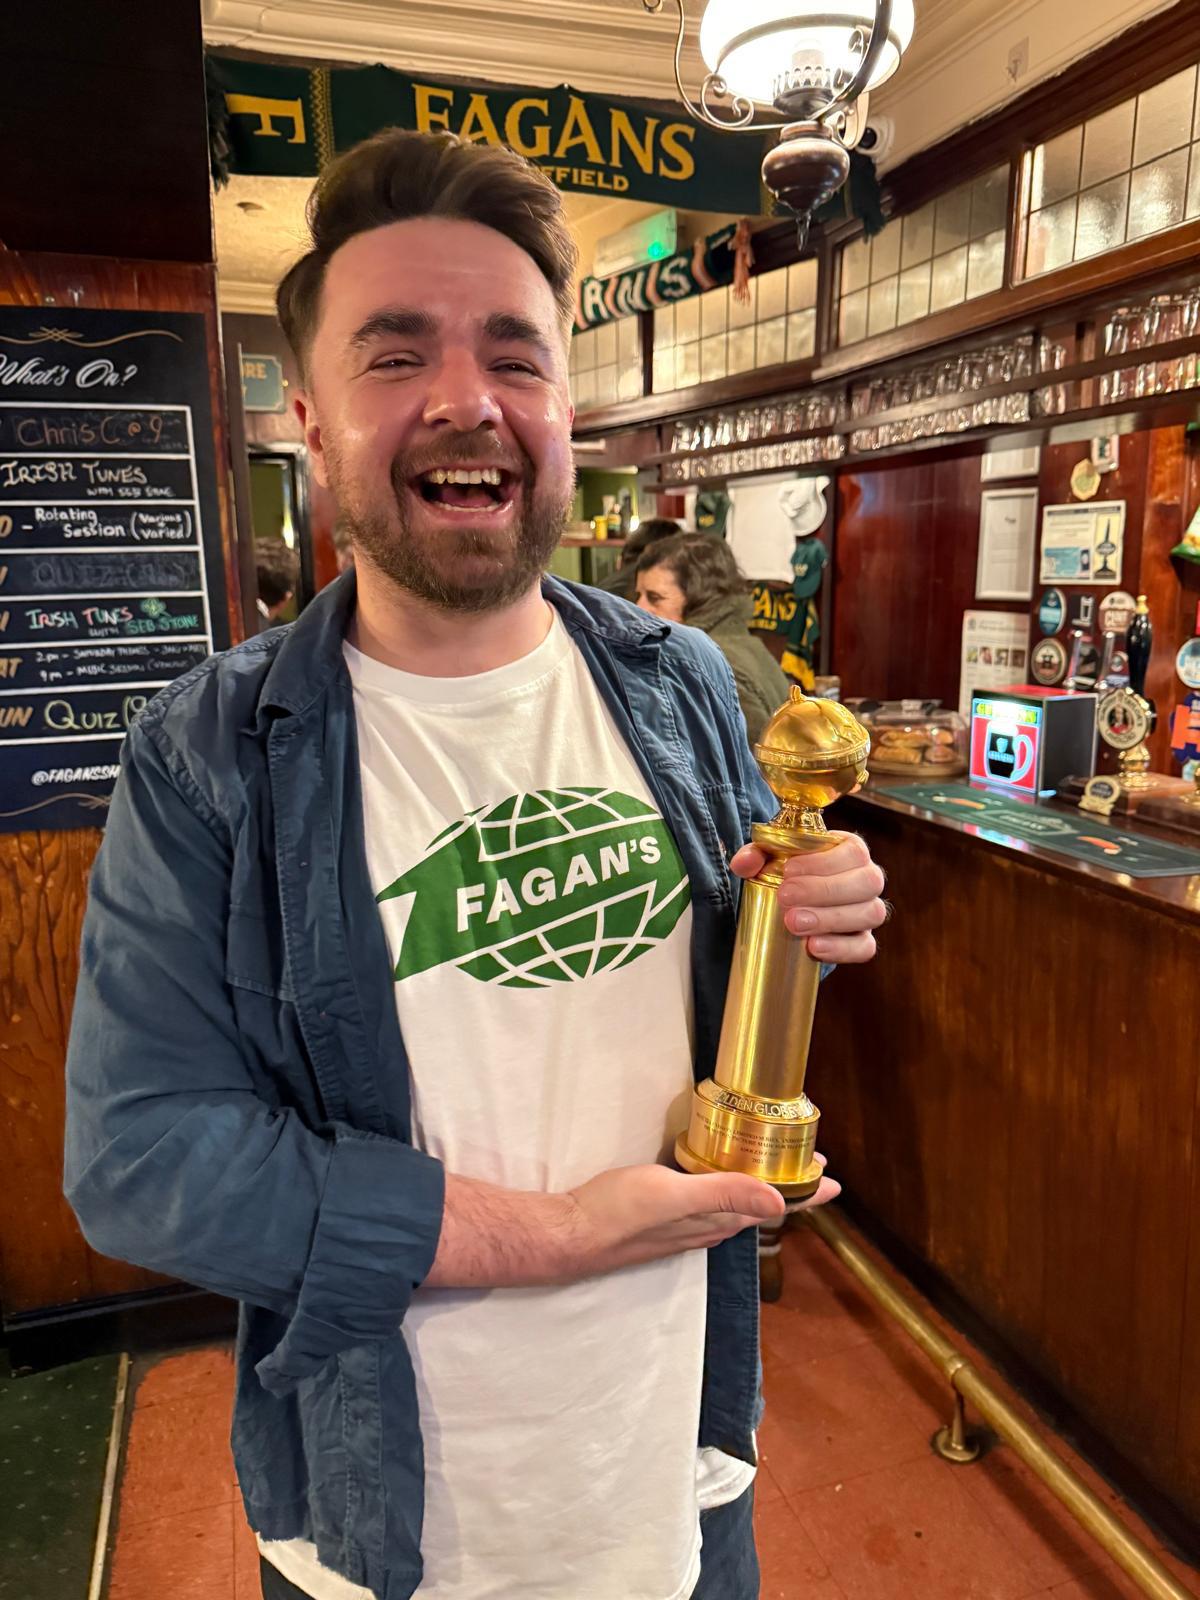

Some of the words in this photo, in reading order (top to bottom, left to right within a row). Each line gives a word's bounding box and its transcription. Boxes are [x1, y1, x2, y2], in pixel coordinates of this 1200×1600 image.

[411, 83, 697, 181] FAGANS
[76, 358, 138, 389] On?
[82, 461, 148, 485] TUNES
[35, 507, 98, 528] Rotating
[63, 522, 126, 538] Session
[82, 606, 133, 627] TUNES
[456, 836, 662, 933] FAGAN'S
